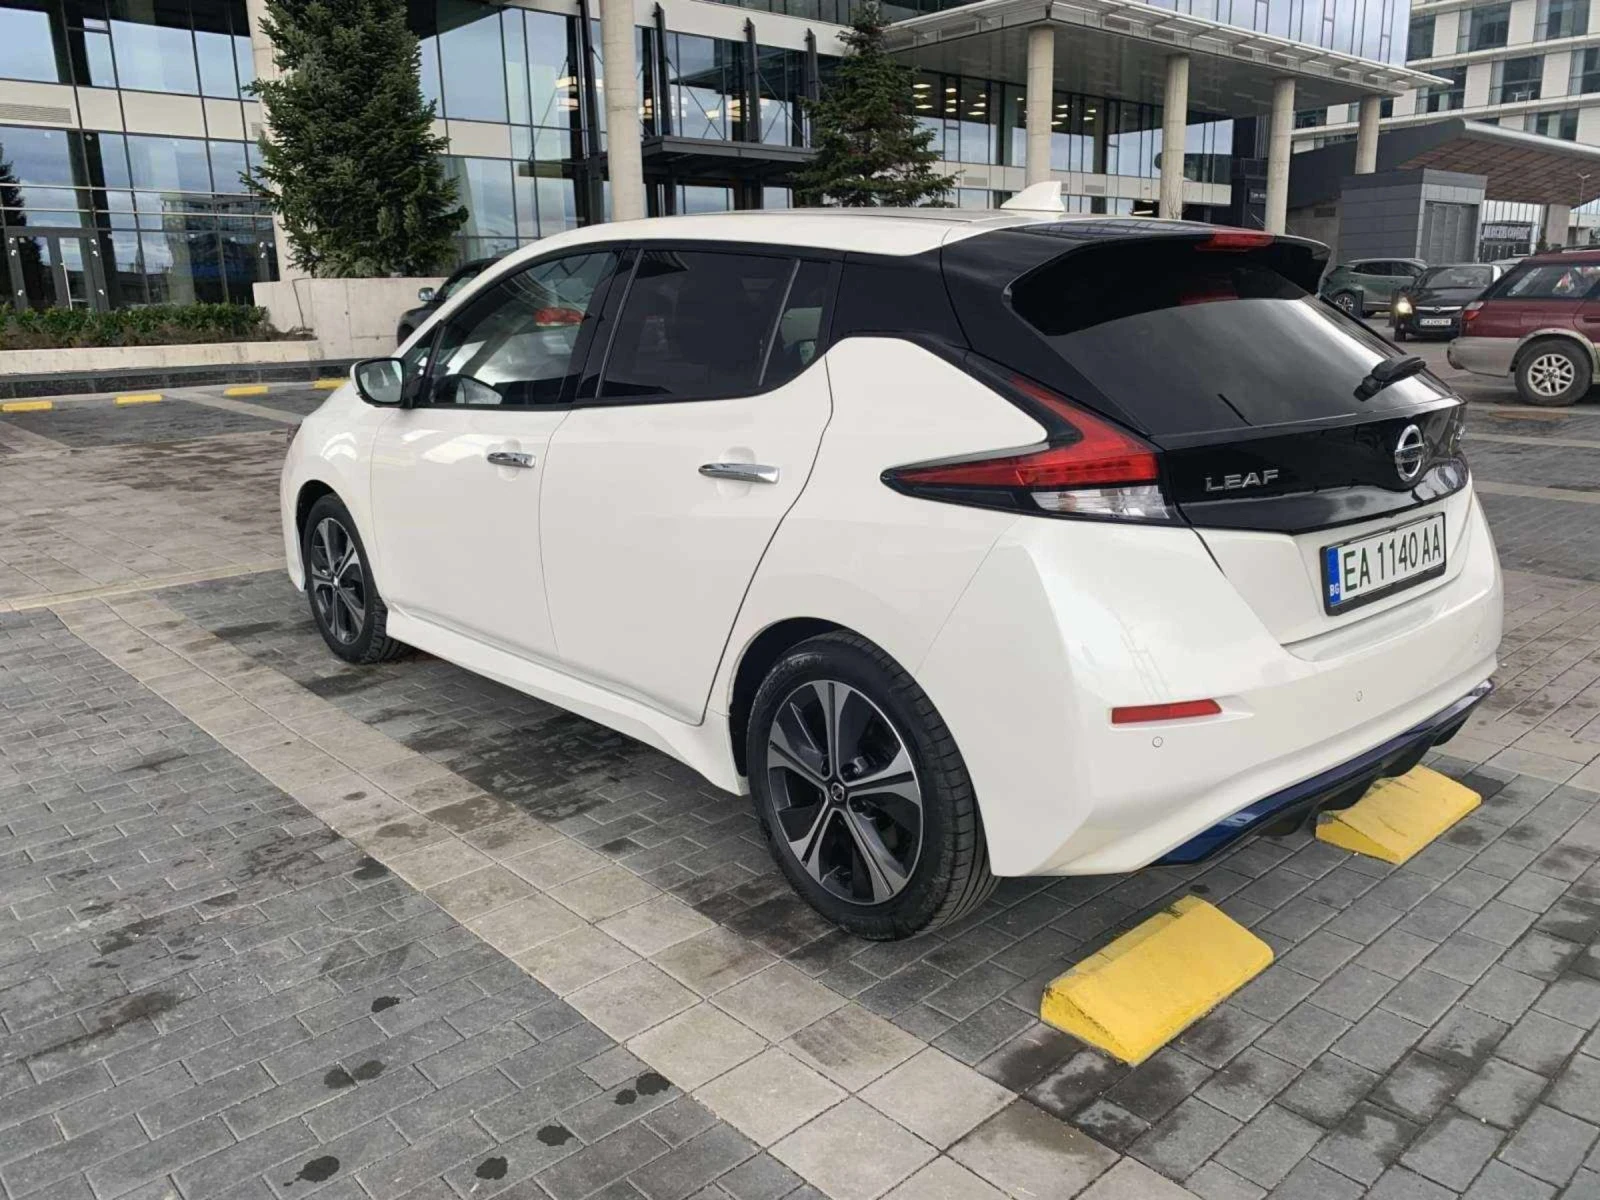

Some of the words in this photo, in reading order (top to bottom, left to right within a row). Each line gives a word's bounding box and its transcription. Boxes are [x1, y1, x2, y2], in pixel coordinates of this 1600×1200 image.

[1205, 469, 1279, 492] LEAF
[1343, 547, 1371, 593] EA
[1377, 531, 1418, 581] 1140
[1421, 523, 1441, 565] AA
[1329, 582, 1340, 597] BG
